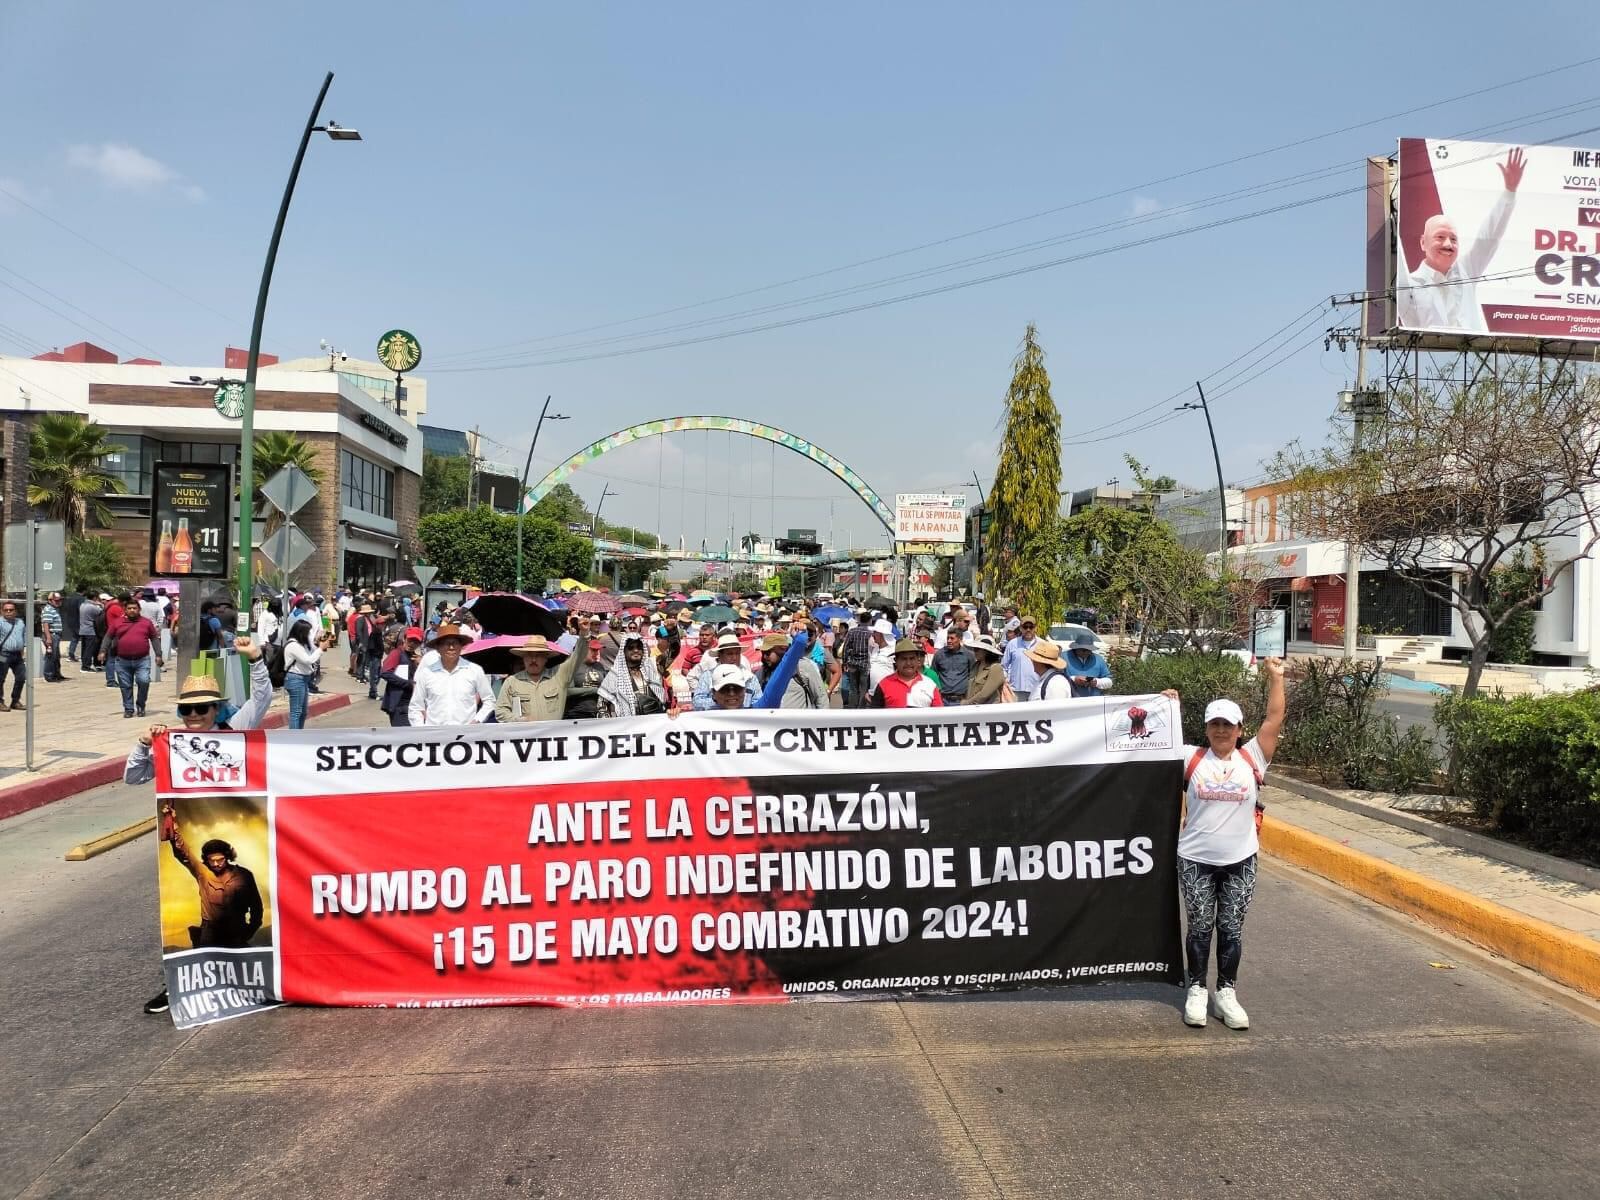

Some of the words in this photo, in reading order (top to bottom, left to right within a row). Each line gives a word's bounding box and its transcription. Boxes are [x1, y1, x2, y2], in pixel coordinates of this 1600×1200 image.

[1564, 175, 1597, 187] VOTA
[1579, 197, 1586, 205] 2
[1535, 229, 1587, 253] DR.
[1535, 253, 1600, 288] CR
[1514, 313, 1529, 321] que
[1539, 314, 1565, 322] Cuarta
[171, 497, 211, 506] BOTELLA
[176, 488, 207, 497] NUEVA
[900, 523, 909, 532] DE
[913, 522, 959, 533] NARANJA
[316, 735, 504, 772] SECCIÓN
[510, 736, 568, 762] VII
[578, 732, 655, 760] DEL
[665, 725, 877, 756] SNTE-CNTE
[888, 719, 1054, 749] CHIAPAS
[1109, 740, 1168, 750] Venceremos
[182, 765, 241, 783] CNTE
[528, 799, 632, 844] ANTE
[645, 797, 693, 838] LA
[705, 783, 930, 836] CERRAZÓN,
[311, 866, 467, 915] RUMBO
[481, 864, 532, 906] AL
[545, 856, 652, 902] PARO
[665, 848, 891, 896] INDEFINIDO
[904, 847, 956, 889] DE
[969, 836, 1154, 887] LABORES
[433, 925, 494, 971] ¡15
[508, 920, 558, 962] DE
[571, 914, 678, 959] MAYO
[691, 907, 909, 952] COMBATIVO
[921, 899, 1029, 940] 2024!
[177, 960, 238, 993] HASTA
[242, 960, 265, 986] LA
[783, 980, 838, 993] UNIDOS,
[842, 975, 939, 990] ORGANIZADOS
[943, 975, 951, 985] Y
[955, 968, 1062, 985] DISCIPLINADOS,
[1066, 961, 1169, 979] ¡VENCEREMOS!
[615, 987, 731, 1003] TRABAJADORES
